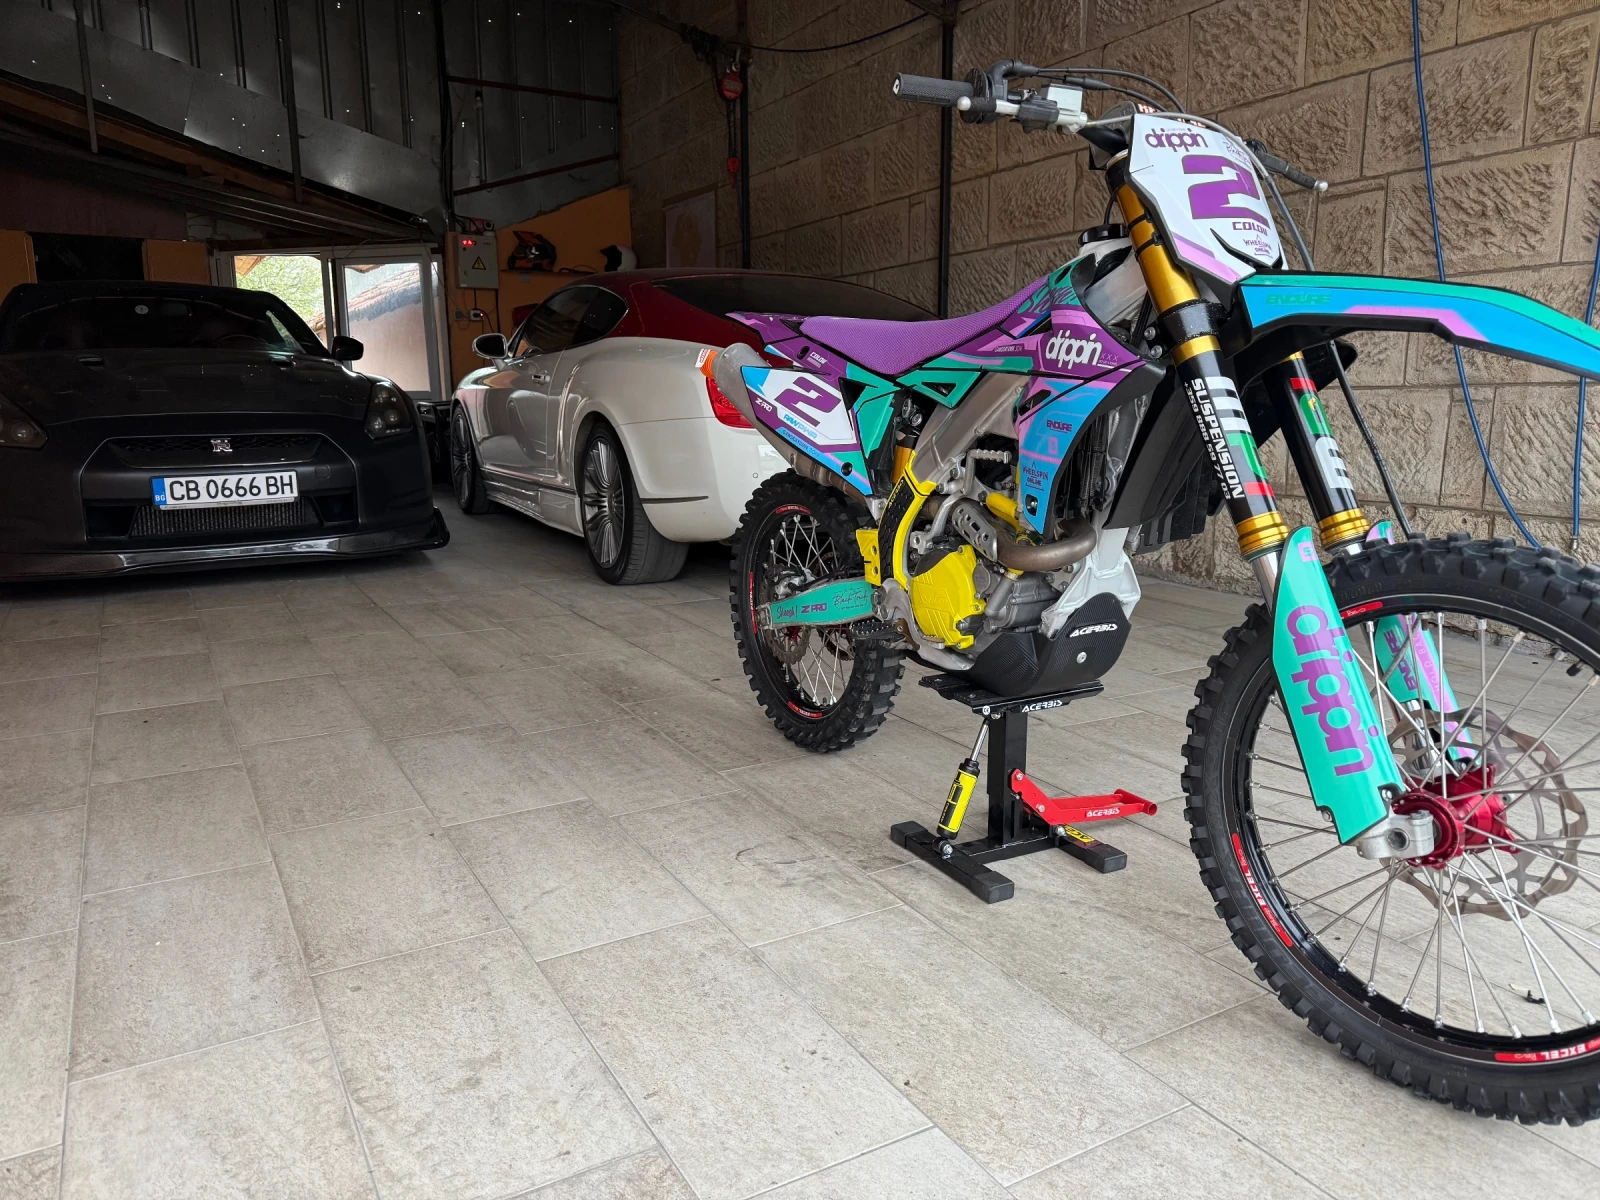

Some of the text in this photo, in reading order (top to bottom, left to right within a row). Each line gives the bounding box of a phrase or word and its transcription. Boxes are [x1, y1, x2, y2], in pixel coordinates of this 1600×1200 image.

[1182, 154, 1271, 229] 2
[774, 376, 842, 427] 2
[1046, 420, 1072, 432] ENDURE
[1191, 378, 1246, 499] SUSPENSION
[1022, 466, 1049, 481] WHEELSPIN
[155, 474, 294, 502] BG CB 0666 BH
[1069, 623, 1118, 638] ACERBIS
[1383, 629, 1418, 691] ENDRE
[1286, 605, 1380, 777] drippin
[1021, 699, 1063, 713] ACERBIS
[1086, 807, 1120, 818] ACERBIS
[1245, 869, 1267, 906] EXCEL
[1540, 1043, 1587, 1060] EXCEL
